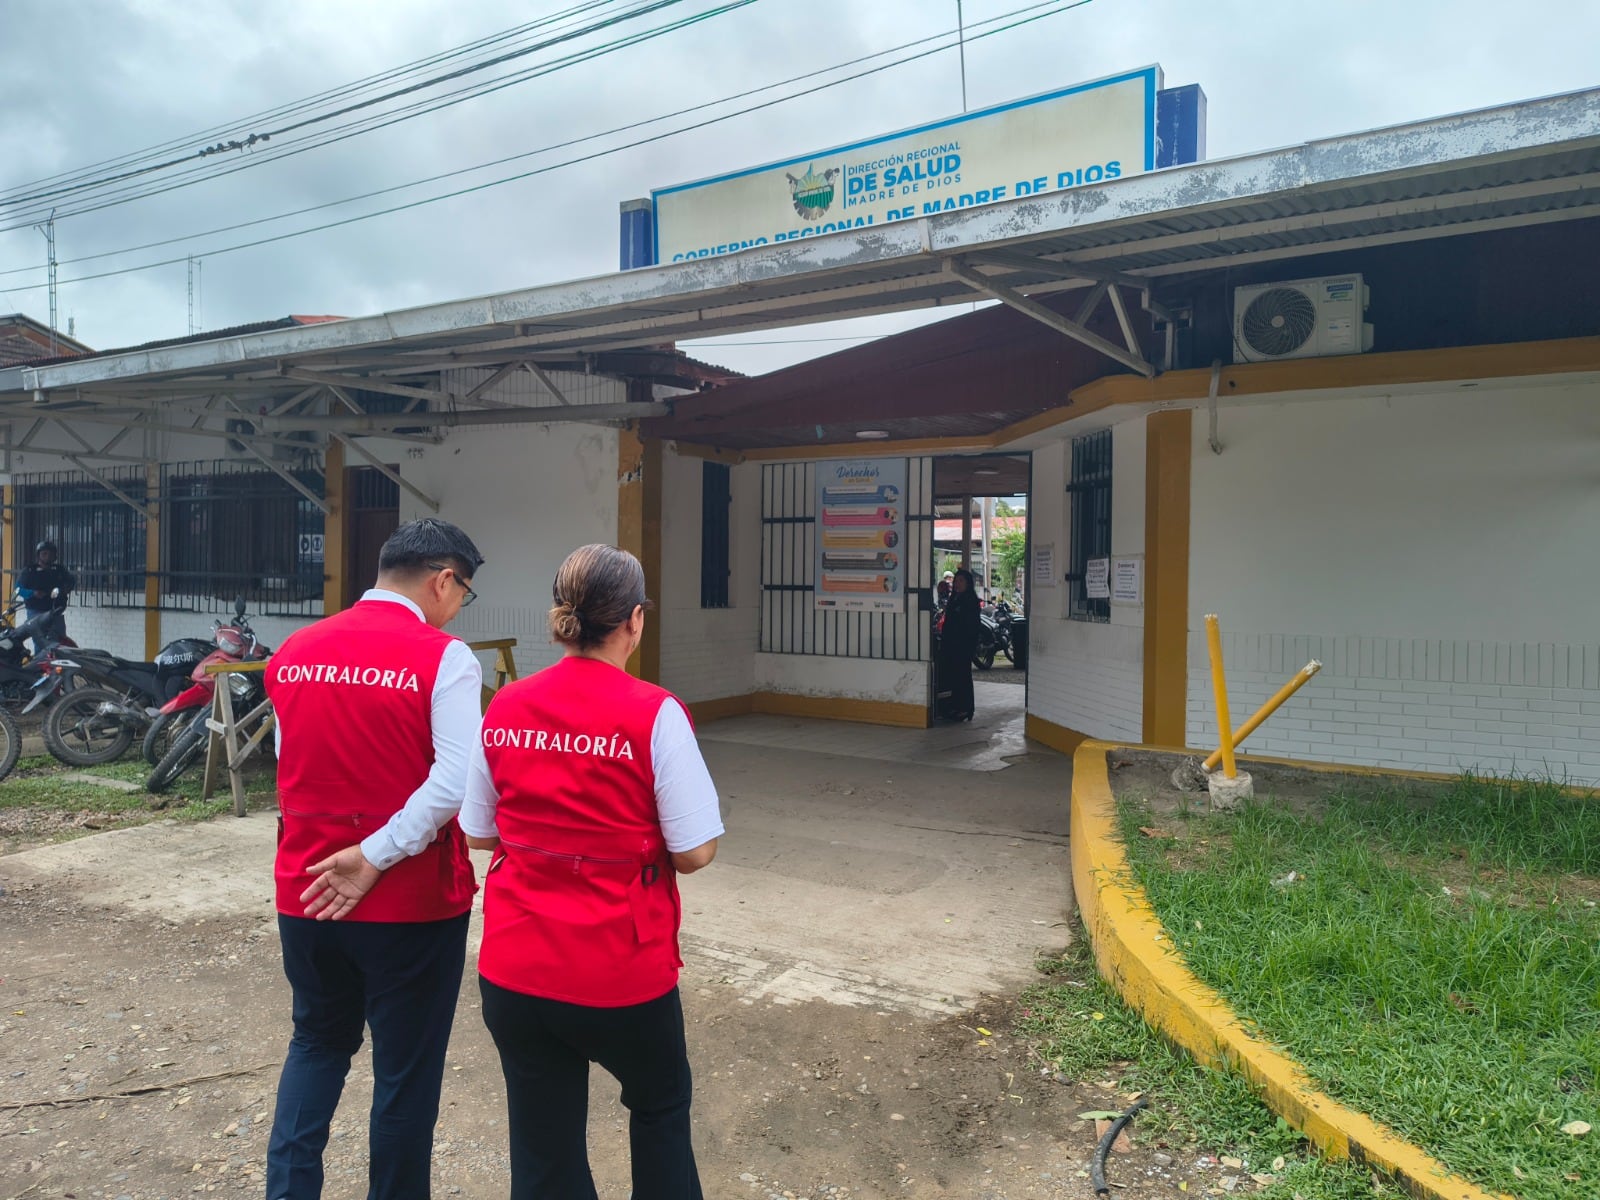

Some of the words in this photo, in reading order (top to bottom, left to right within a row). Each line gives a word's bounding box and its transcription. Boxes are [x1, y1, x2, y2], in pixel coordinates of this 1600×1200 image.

[848, 154, 903, 176] DIRECCIÓN
[907, 142, 961, 162] REGIONAL
[848, 173, 877, 195] DE
[883, 154, 961, 187] SALUD
[1058, 160, 1121, 189] DIOS
[848, 189, 894, 207] MADRE
[903, 184, 919, 195] DE
[927, 174, 961, 189] DIOS
[836, 465, 880, 479] Derechos
[276, 664, 419, 692] CONTRALORÍA
[483, 728, 633, 760] CONTRALORÍA
